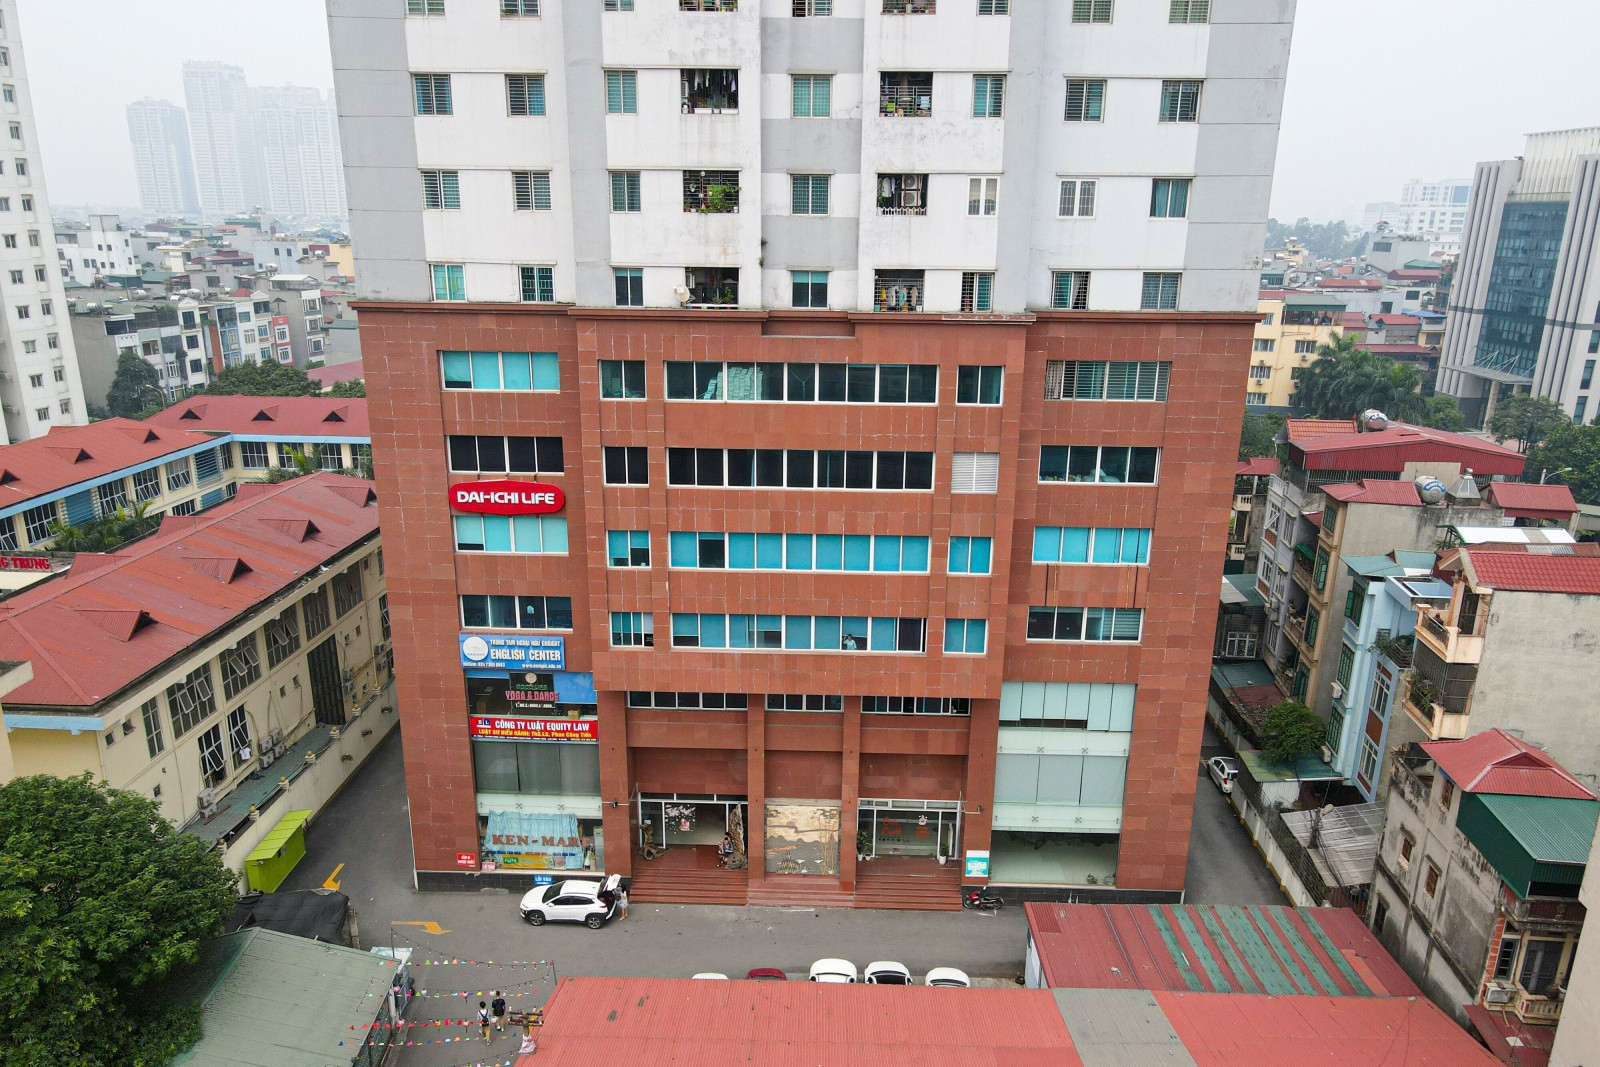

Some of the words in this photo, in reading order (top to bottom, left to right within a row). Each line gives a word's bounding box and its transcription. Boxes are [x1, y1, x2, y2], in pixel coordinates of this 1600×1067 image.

[457, 491, 519, 503] DAI-ICHI
[521, 493, 555, 504] LIFE
[11, 556, 51, 569] TRUNG
[490, 648, 525, 660] ENGLISH
[529, 650, 560, 661] CENTER
[505, 691, 525, 700] YOGA
[527, 691, 533, 700] &
[533, 692, 559, 701] DANCE
[495, 720, 515, 729] CÔNG
[527, 721, 544, 731] LUẬT
[547, 722, 571, 731] EQUITY
[573, 723, 590, 731] LAW
